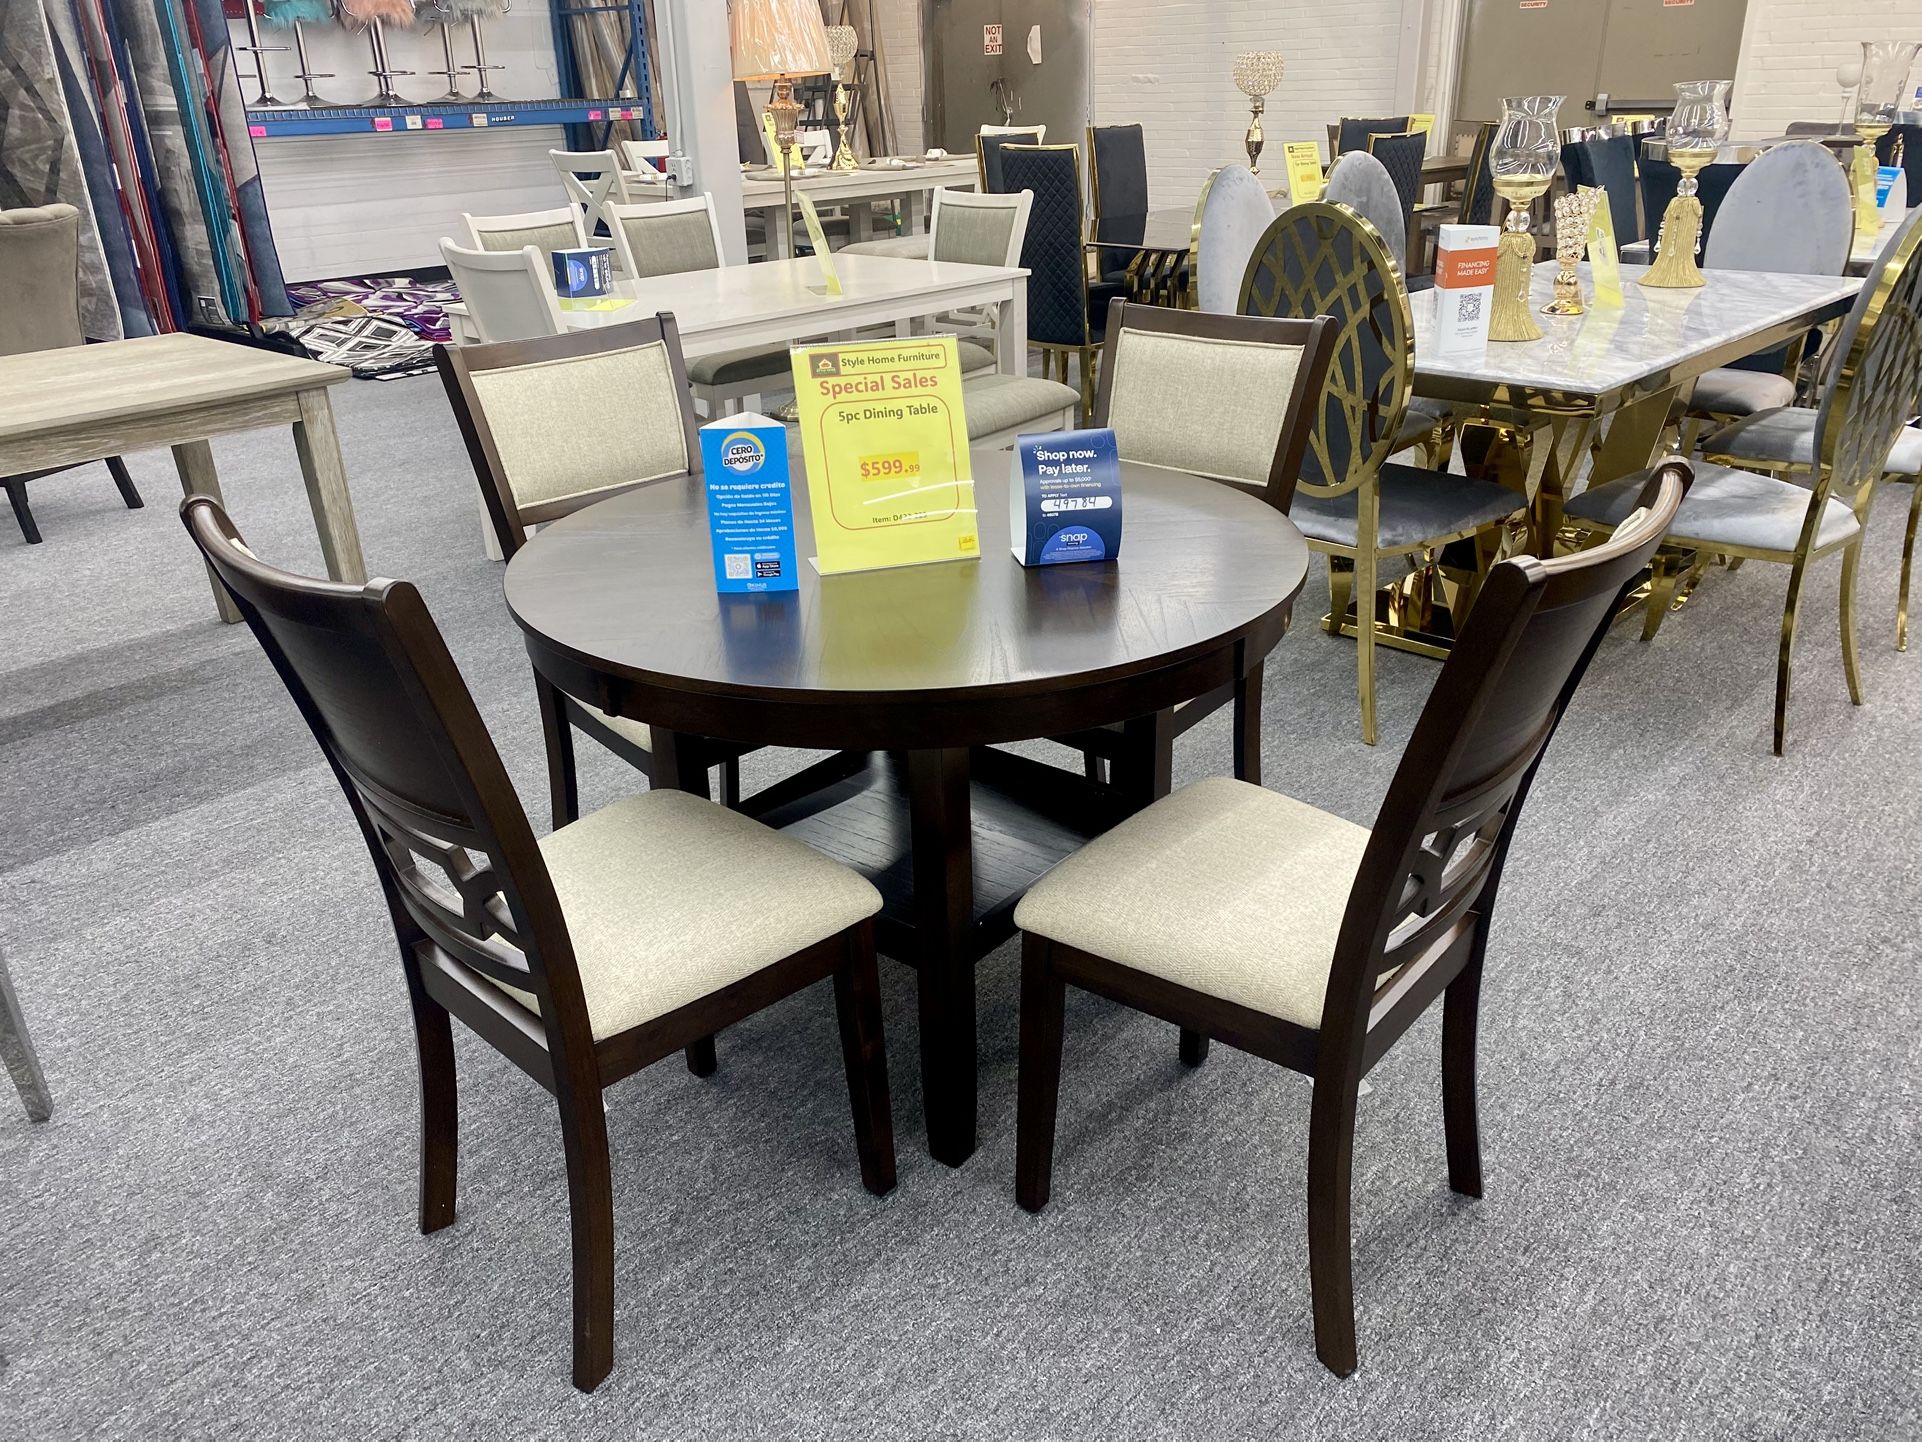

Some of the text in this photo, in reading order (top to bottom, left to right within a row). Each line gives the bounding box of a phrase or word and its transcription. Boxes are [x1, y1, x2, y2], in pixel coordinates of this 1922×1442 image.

[986, 26, 1001, 35] NOT
[986, 44, 1001, 53] EXIT
[1458, 260, 1490, 269] FINANCING
[841, 352, 941, 368] Style Home Furniture
[820, 374, 938, 399] Special Sales
[839, 404, 938, 424] 5pc Dining Table
[731, 446, 753, 456] CERO
[1036, 450, 1097, 461] Shop now.
[860, 458, 920, 478] $599.99
[1038, 464, 1090, 476] Pay later.
[730, 483, 759, 491] requiere
[872, 515, 892, 524] Item:
[1061, 532, 1087, 543] snap
